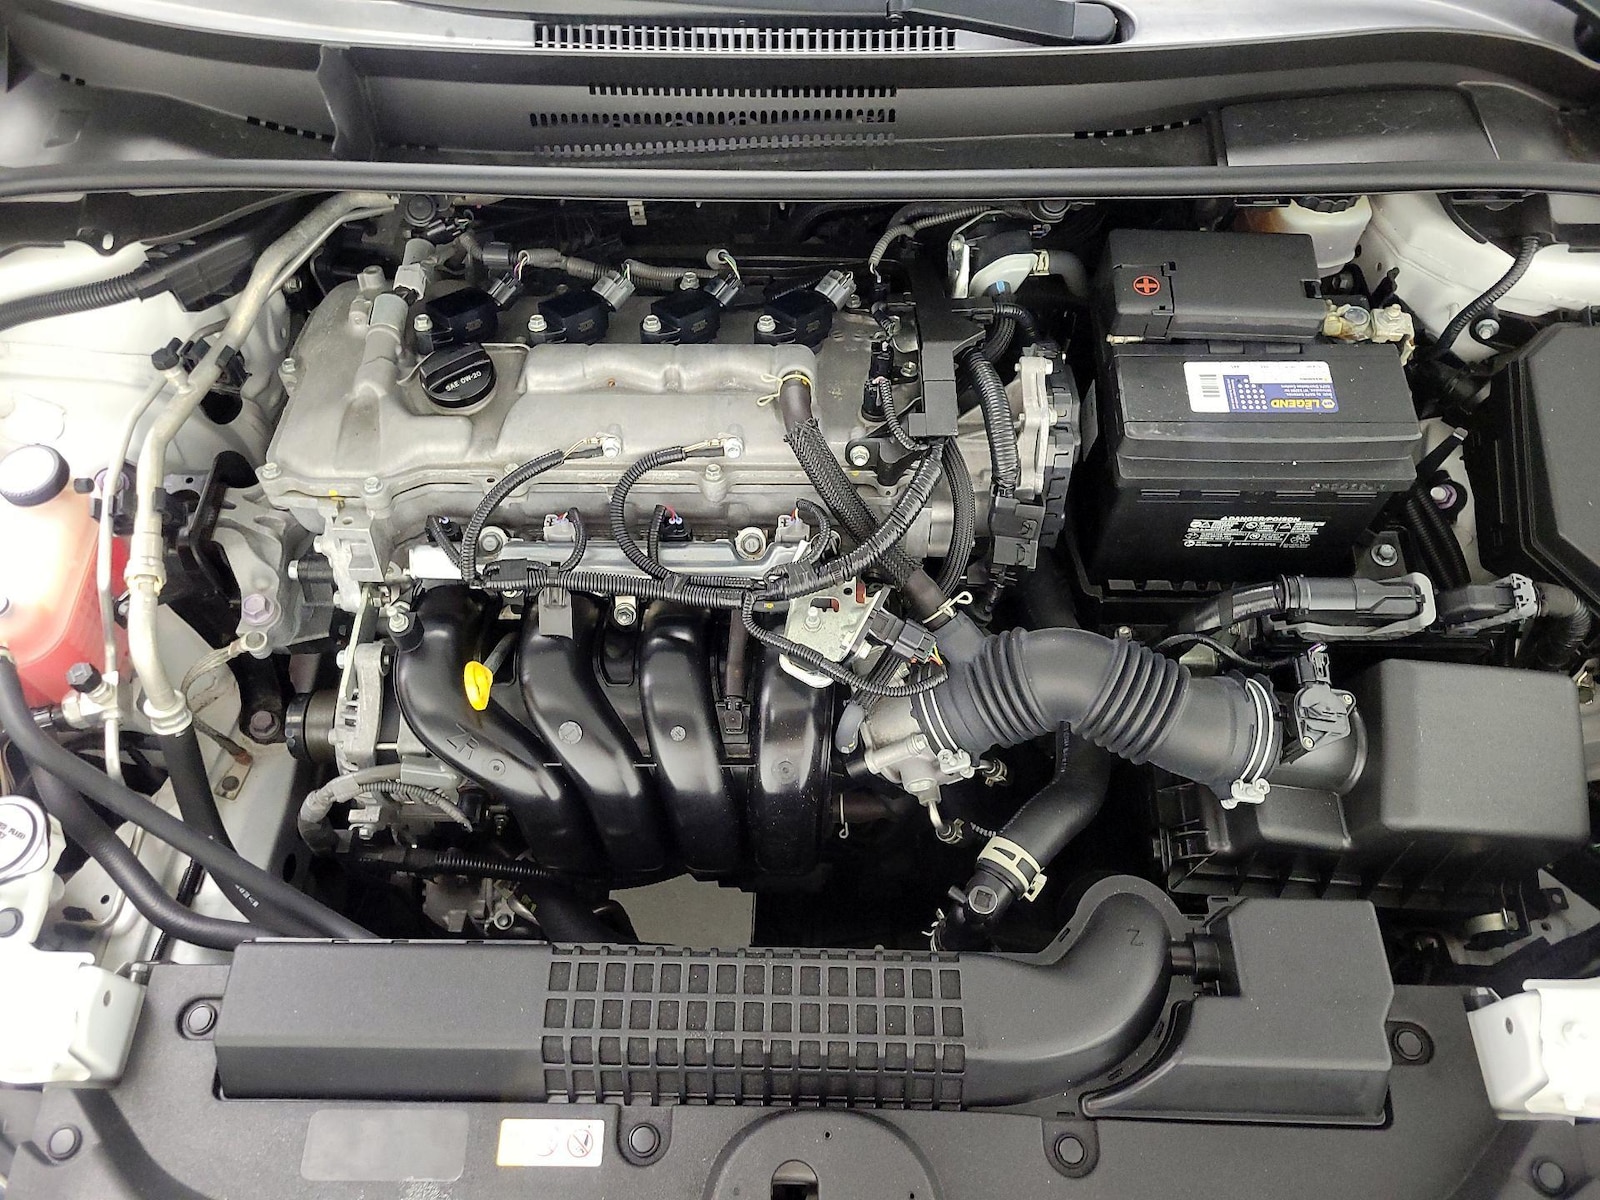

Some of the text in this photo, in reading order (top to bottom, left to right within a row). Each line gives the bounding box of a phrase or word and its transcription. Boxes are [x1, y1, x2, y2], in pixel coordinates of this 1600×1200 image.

[445, 370, 482, 392] SAE 0W-20
[1270, 398, 1320, 408] LEGEND
